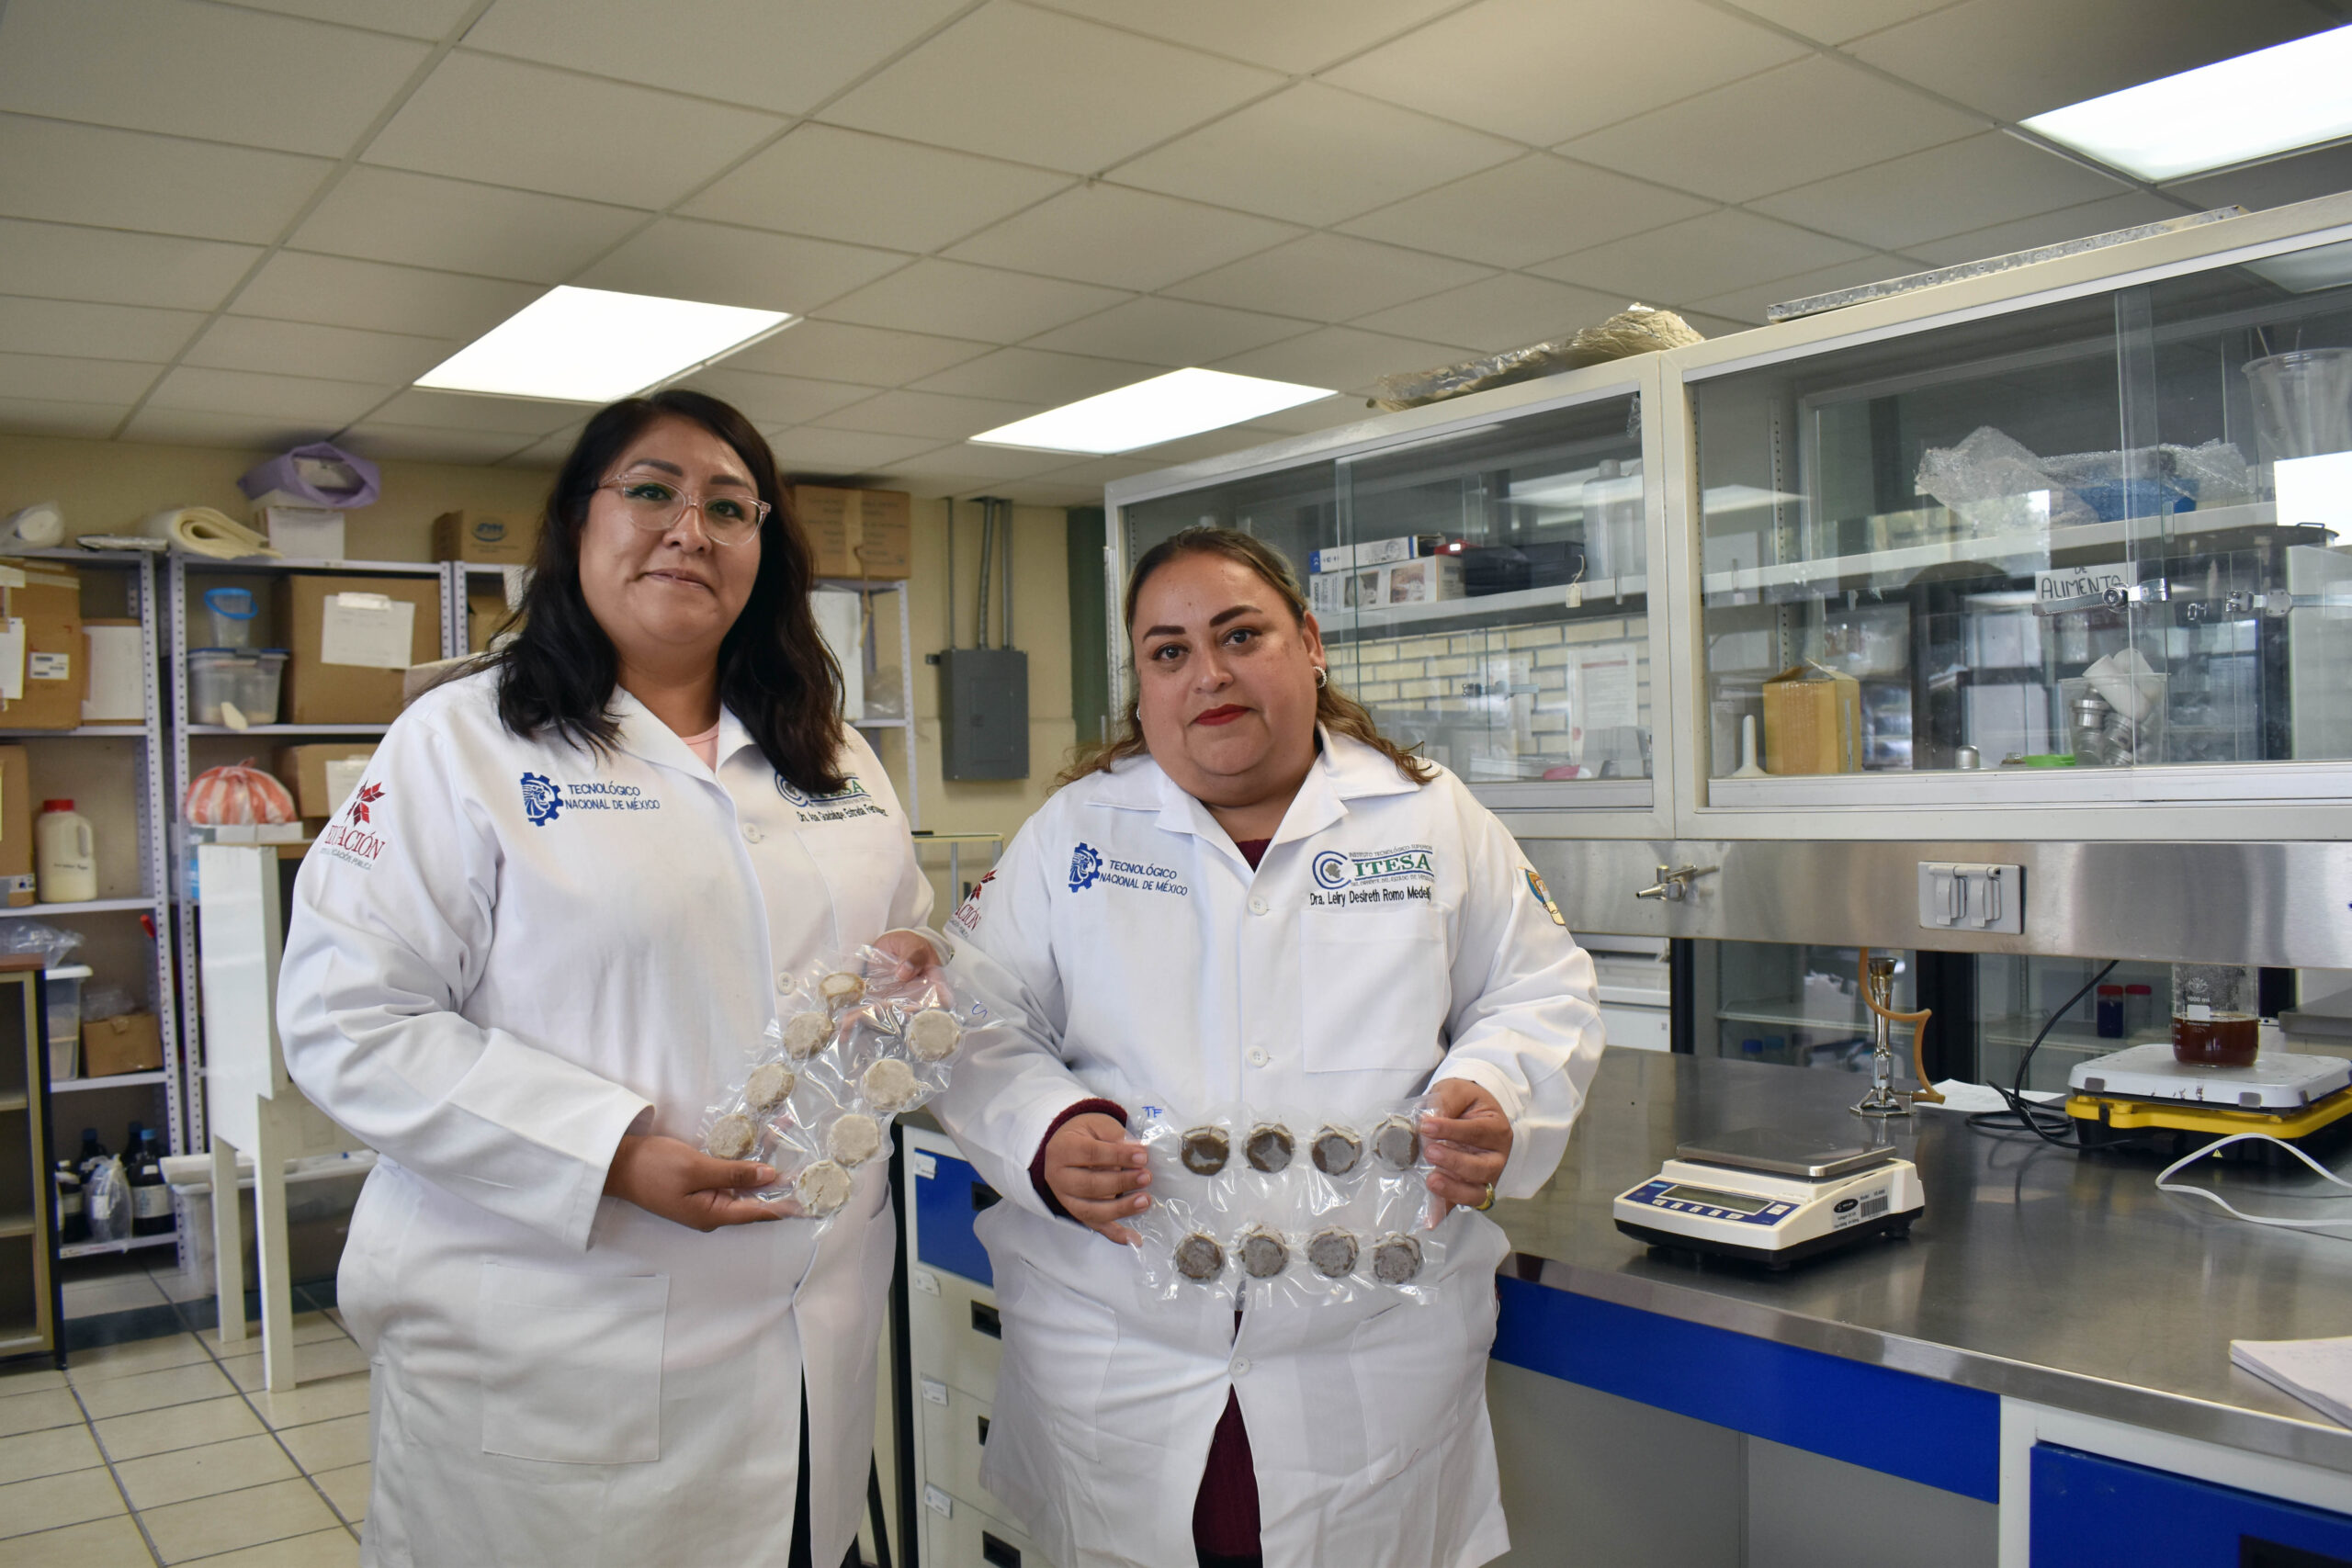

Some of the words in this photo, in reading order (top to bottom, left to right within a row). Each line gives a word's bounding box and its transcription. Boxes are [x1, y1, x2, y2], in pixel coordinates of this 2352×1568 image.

[567, 781, 640, 796] TECNOLÓGICO
[565, 799, 610, 809] NACIONAL
[613, 800, 625, 809] DE
[627, 797, 661, 810] MÉXICO
[1110, 860, 1177, 879] TECNOLÓGICO
[1354, 853, 1432, 876] ITESA
[1100, 873, 1139, 889] NACIONAL
[1142, 880, 1153, 890] DE
[1156, 879, 1188, 896] MÉXICO
[1310, 893, 1325, 905] Dra.
[1350, 889, 1380, 903] Desireth
[1383, 888, 1404, 902] Romo
